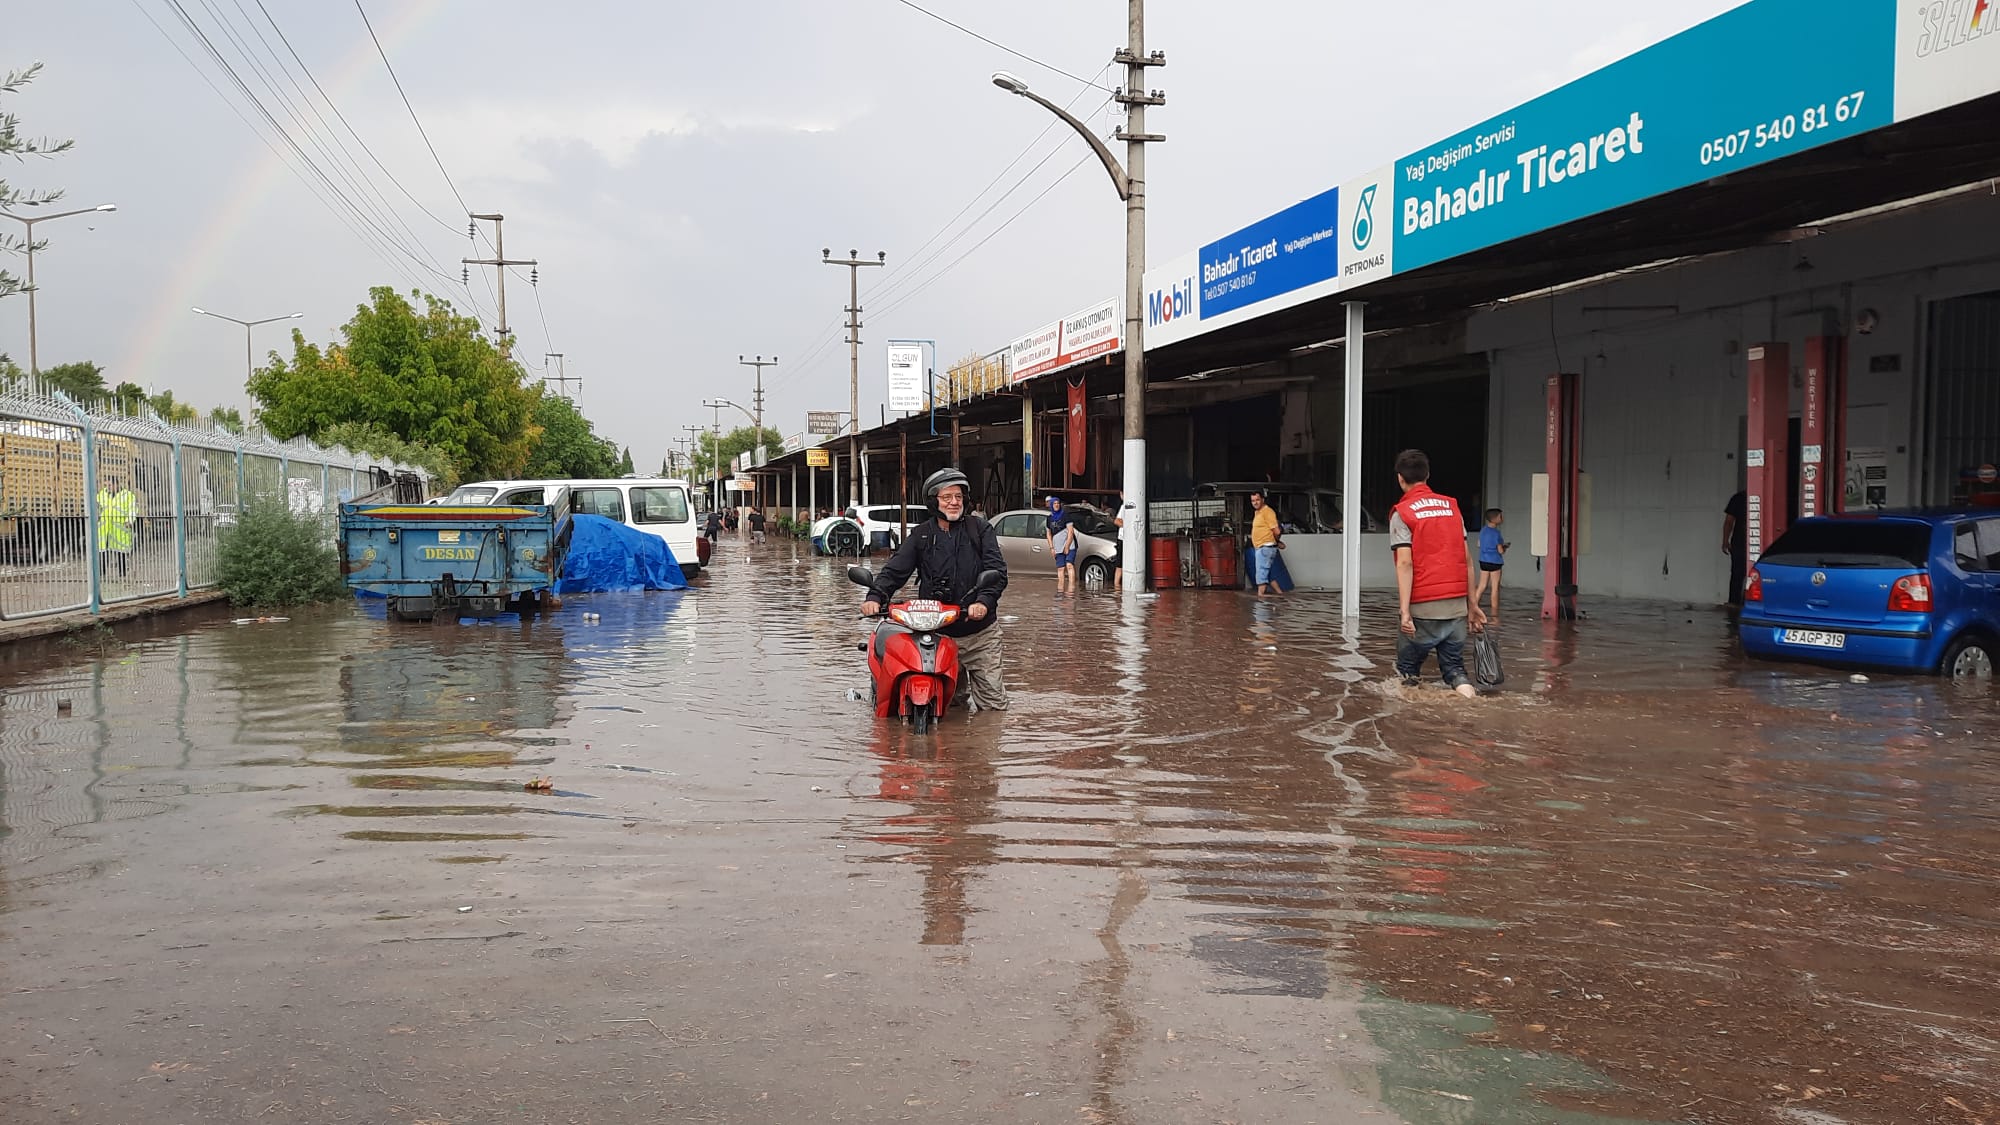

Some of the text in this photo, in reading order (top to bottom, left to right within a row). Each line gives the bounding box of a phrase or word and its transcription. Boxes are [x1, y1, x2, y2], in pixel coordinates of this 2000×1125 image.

[1700, 90, 1865, 166] 0507 540 81 67
[1406, 121, 1516, 182] Yağ Değişim Servisi
[1403, 111, 1644, 235] Bahadır Ticaret
[1312, 226, 1334, 242] Merkezi
[1203, 238, 1278, 284] Bahadır Ticaret
[1344, 253, 1385, 277] PETRONAS
[1240, 270, 1257, 289] 8167
[1149, 277, 1192, 328] Mobil
[892, 354, 918, 362] OLGUN
[1808, 368, 1816, 429] WERTHER
[425, 548, 475, 560] DESAN
[1785, 630, 1844, 647] 45 AGP 319
